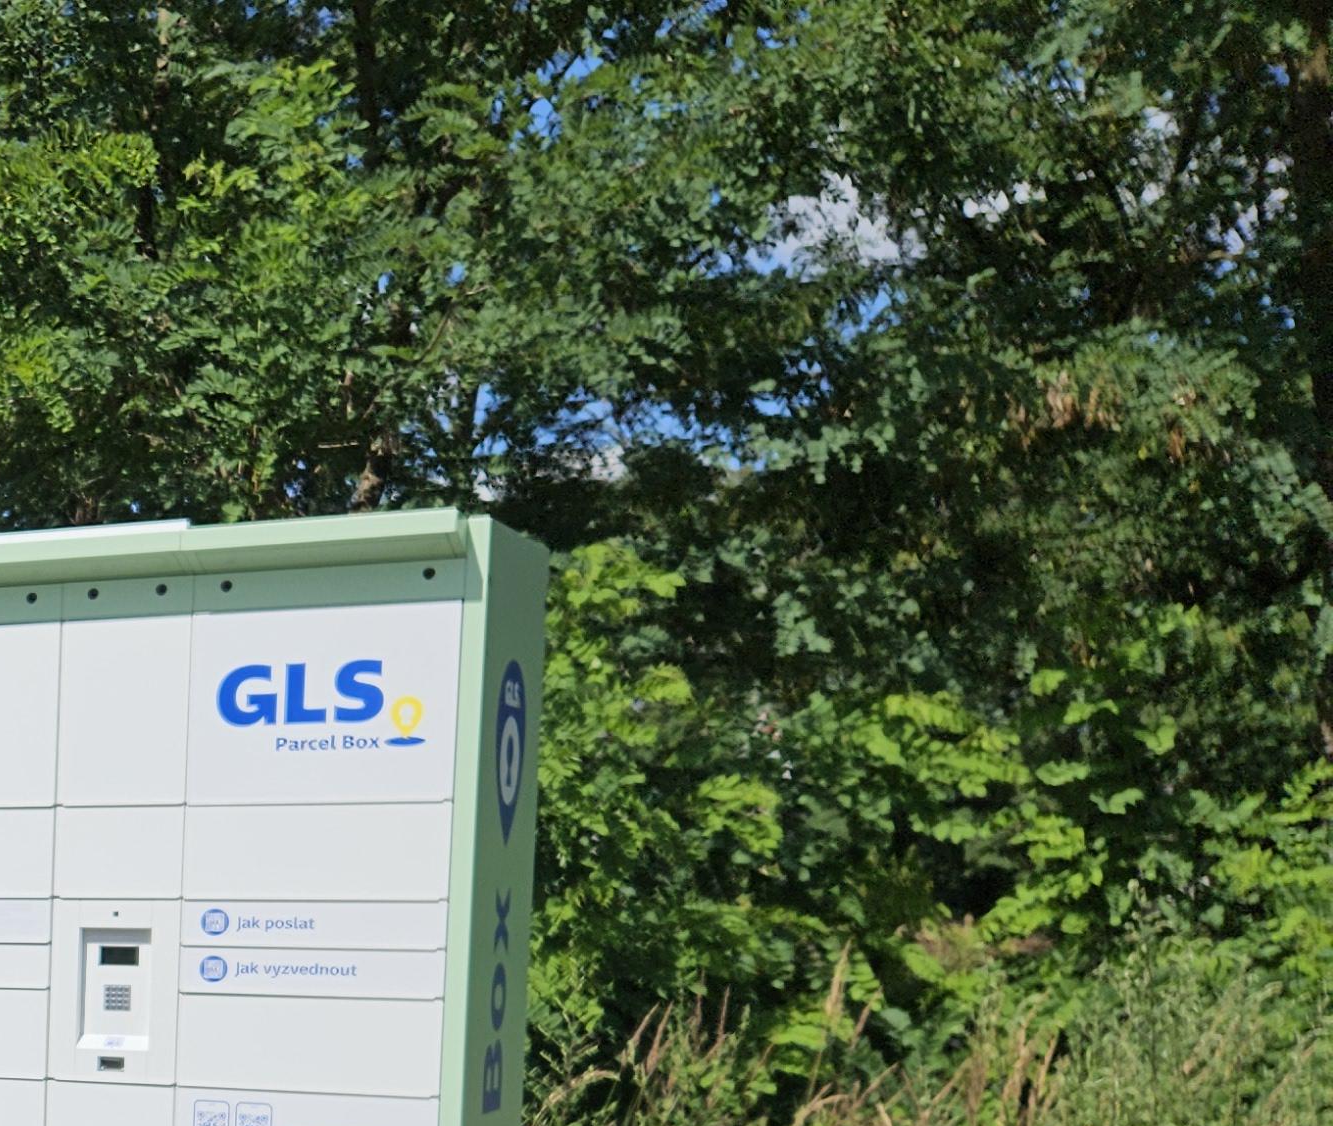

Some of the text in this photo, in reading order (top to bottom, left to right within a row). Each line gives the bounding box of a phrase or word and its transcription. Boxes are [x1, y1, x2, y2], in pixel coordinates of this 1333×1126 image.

[216, 659, 384, 727] GLS
[276, 735, 380, 751] Parcel Box
[237, 916, 315, 932] Jak poslat
[235, 962, 357, 978] Jak vyzvednout
[482, 887, 512, 1115] Box
